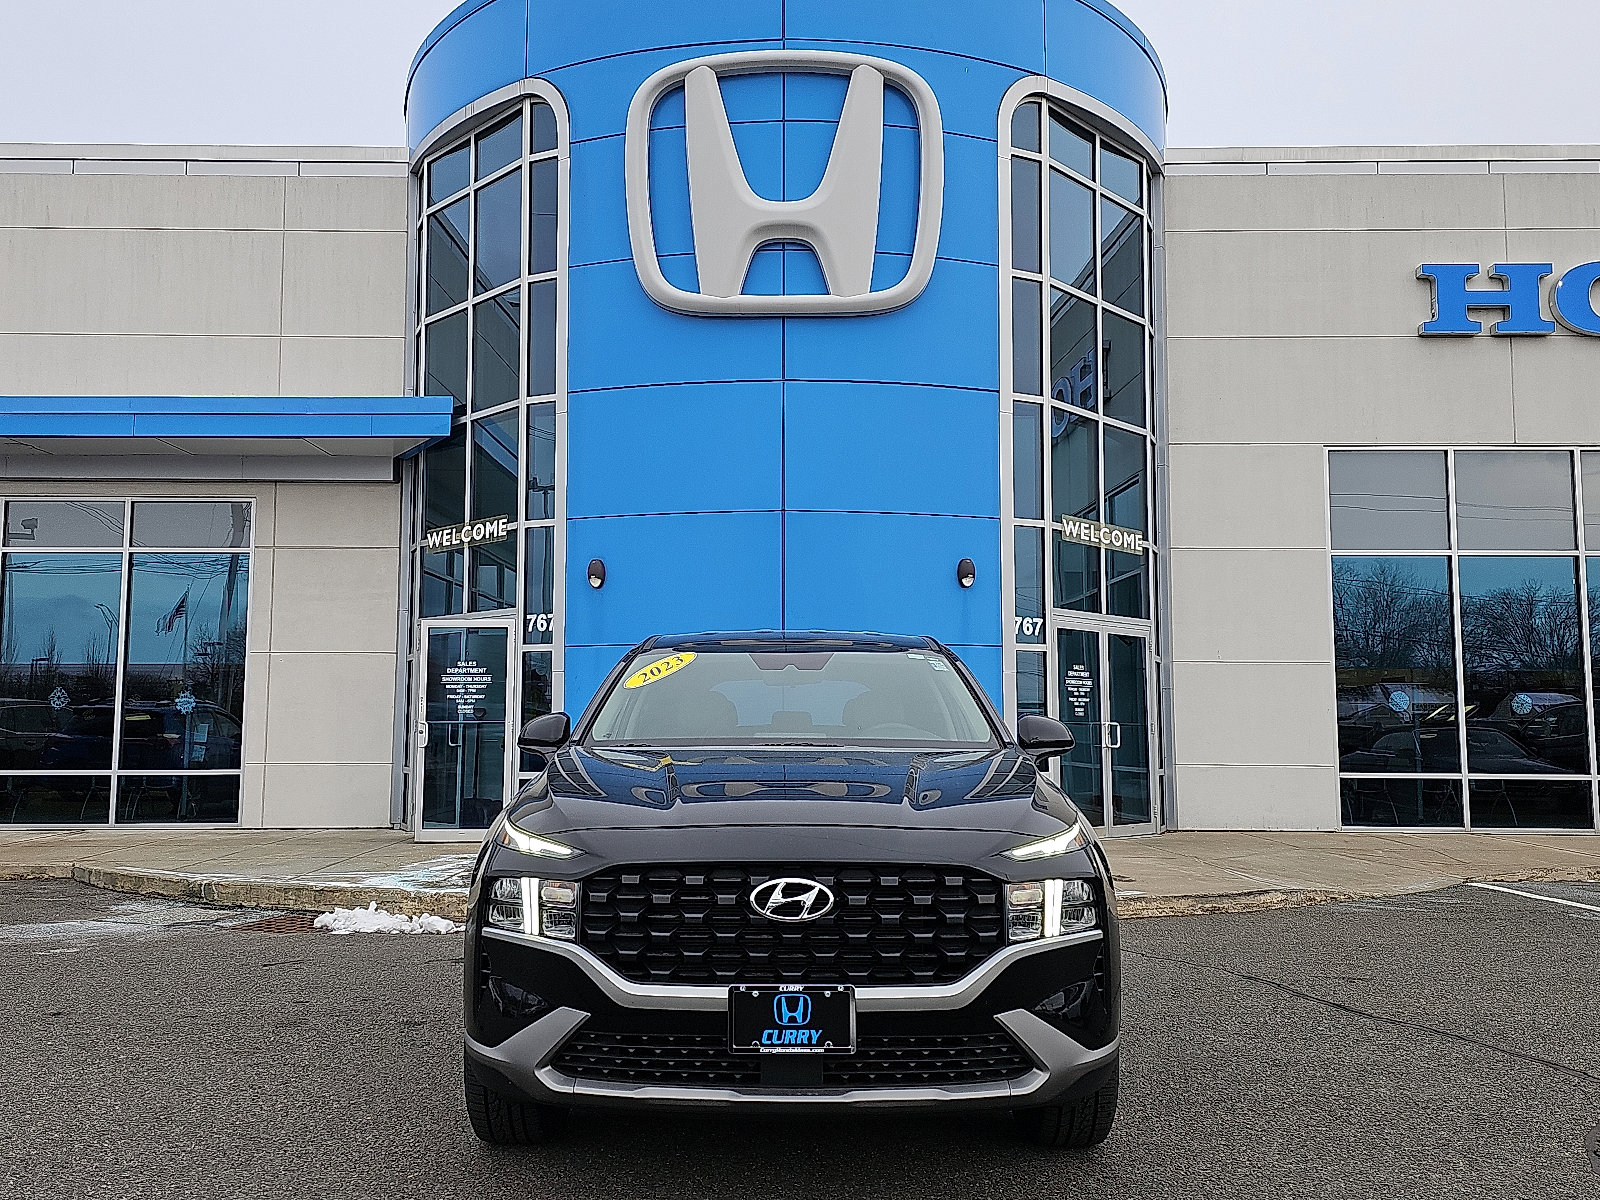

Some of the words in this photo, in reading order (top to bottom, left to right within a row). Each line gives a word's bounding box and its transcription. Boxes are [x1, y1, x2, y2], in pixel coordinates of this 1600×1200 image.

[426, 518, 508, 549] WELCOME
[1061, 518, 1143, 551] WELCOME
[1013, 616, 1044, 637] 767
[637, 656, 685, 684] 2023
[761, 1029, 823, 1045] CURRY
